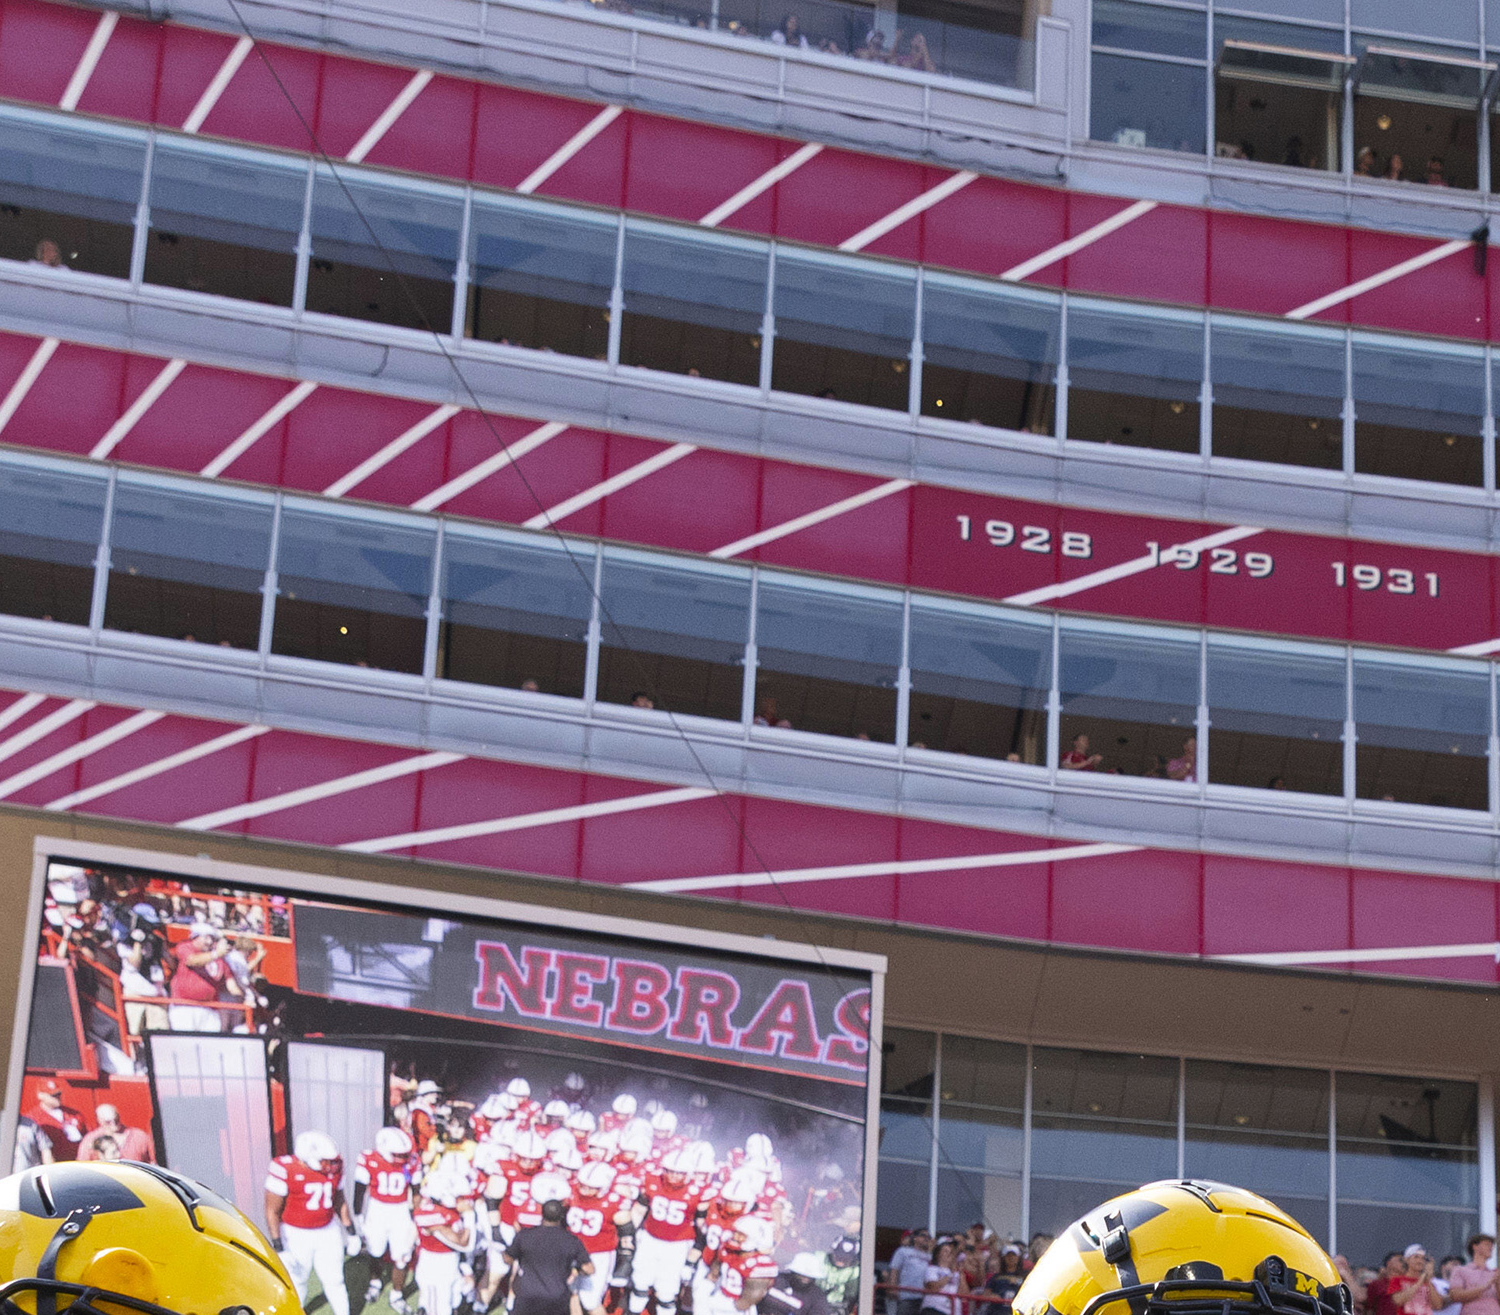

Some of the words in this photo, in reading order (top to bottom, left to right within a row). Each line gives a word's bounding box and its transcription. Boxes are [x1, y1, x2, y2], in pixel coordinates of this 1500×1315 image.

[956, 515, 1092, 559] 1928
[1146, 541, 1275, 578] 1929
[1331, 561, 1441, 598] 1931
[304, 1182, 332, 1210] 71
[377, 1171, 405, 1196] 10
[651, 1196, 687, 1225] 65
[1295, 1272, 1320, 1299] M
